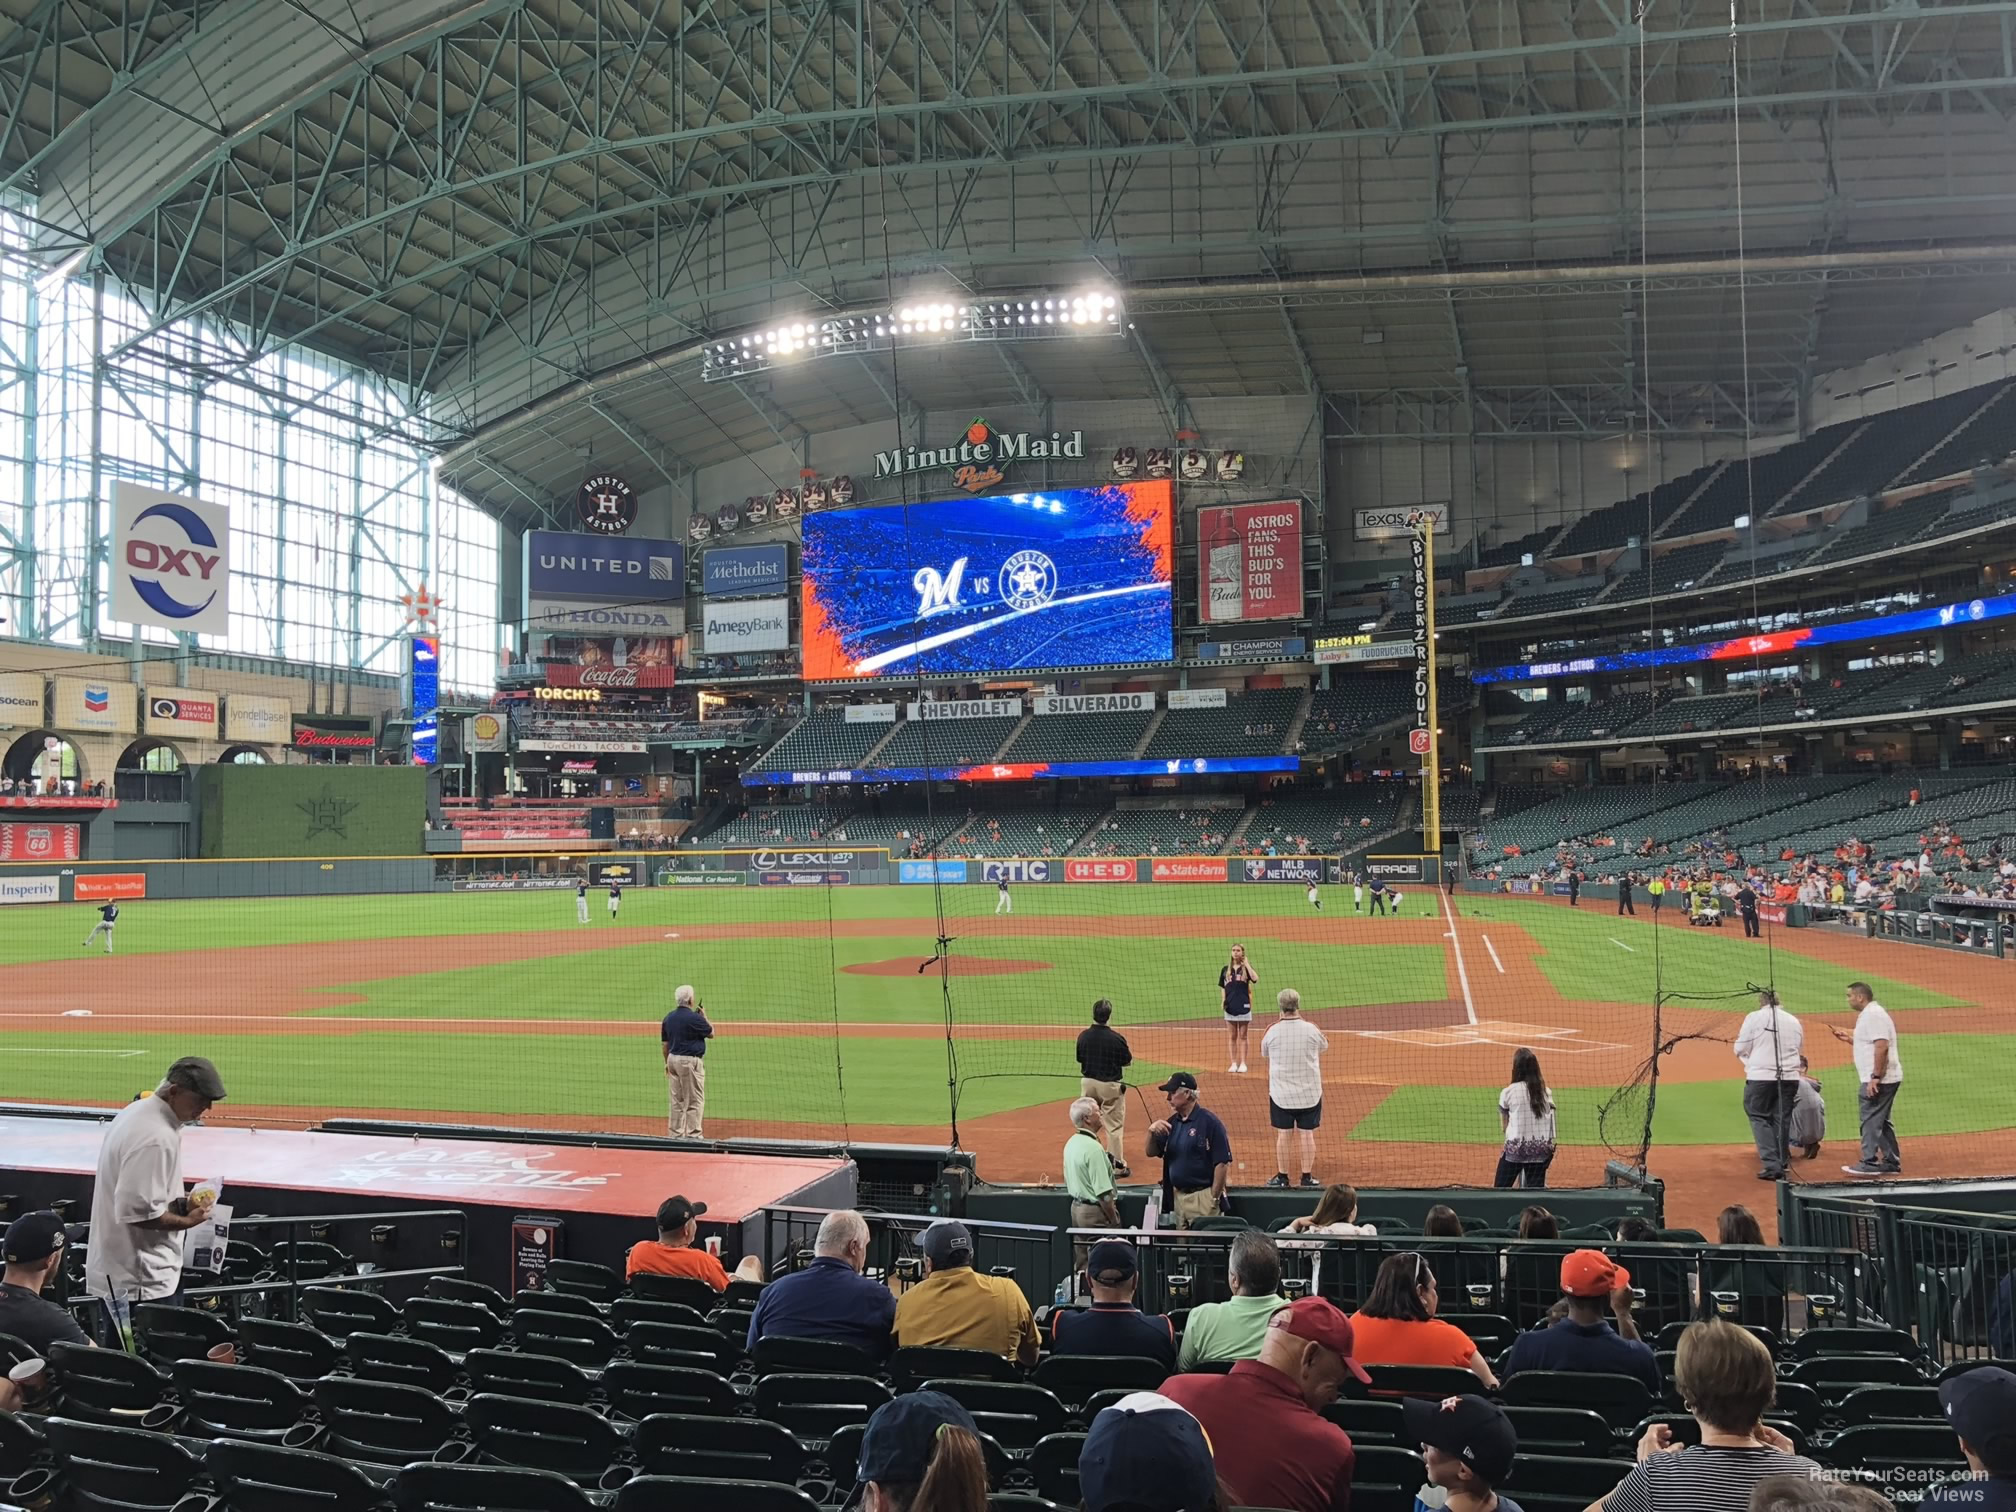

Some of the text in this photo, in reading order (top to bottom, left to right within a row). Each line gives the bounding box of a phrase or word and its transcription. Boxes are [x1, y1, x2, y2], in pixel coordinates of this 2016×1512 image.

[874, 431, 1084, 478] Minute Maid
[1114, 447, 1136, 465] 49
[1147, 448, 1169, 466] 24
[1188, 449, 1199, 467] 5
[832, 475, 850, 492] 42
[953, 464, 1003, 491] Park
[584, 476, 631, 497] HOUSTON
[803, 482, 822, 498] 34
[597, 494, 618, 514] H
[746, 496, 765, 512] 25
[775, 488, 793, 504] 33
[586, 516, 628, 532] ASTROS
[1248, 514, 1293, 529] ASTROS
[1360, 511, 1404, 527] Texas
[1248, 530, 1281, 544] FANS,
[1248, 545, 1274, 557] THIS
[127, 540, 220, 580] OXY
[540, 555, 642, 574] UNITED
[1005, 553, 1050, 572] HOUSTON
[1249, 558, 1284, 571] BUD'S
[710, 561, 779, 580] Methodist
[974, 577, 990, 594] VS
[1249, 573, 1272, 586] FOR
[1008, 593, 1048, 609] ASTROS
[1249, 588, 1276, 600] YOU.
[569, 608, 671, 627] HONDA
[707, 617, 783, 635] AmegyBank
[1233, 641, 1282, 651] CHAMPION
[1315, 635, 1371, 648] 12:57:04 PM
[1320, 645, 1413, 662] Luby's FUDDRUCKERS
[580, 666, 640, 686] Coca-Cola
[1530, 663, 1561, 676] BREWERS
[1569, 659, 1595, 672] ASTROS
[1048, 695, 1142, 713] SILVERADO
[1415, 666, 1427, 727] FOUL
[181, 703, 212, 713] QUANTA
[181, 711, 212, 720] SERVICES
[918, 701, 1011, 719] CHEVROLET
[294, 729, 377, 746] Budweiser
[595, 743, 625, 751] TACOS
[792, 772, 820, 782] BREWERS
[828, 771, 851, 781] ASTROS
[30, 839, 47, 850] 66
[983, 861, 1048, 881] RTIC
[1282, 860, 1304, 869] MLB
[1267, 870, 1319, 879] NETWORK
[2, 884, 54, 897] Insperity
